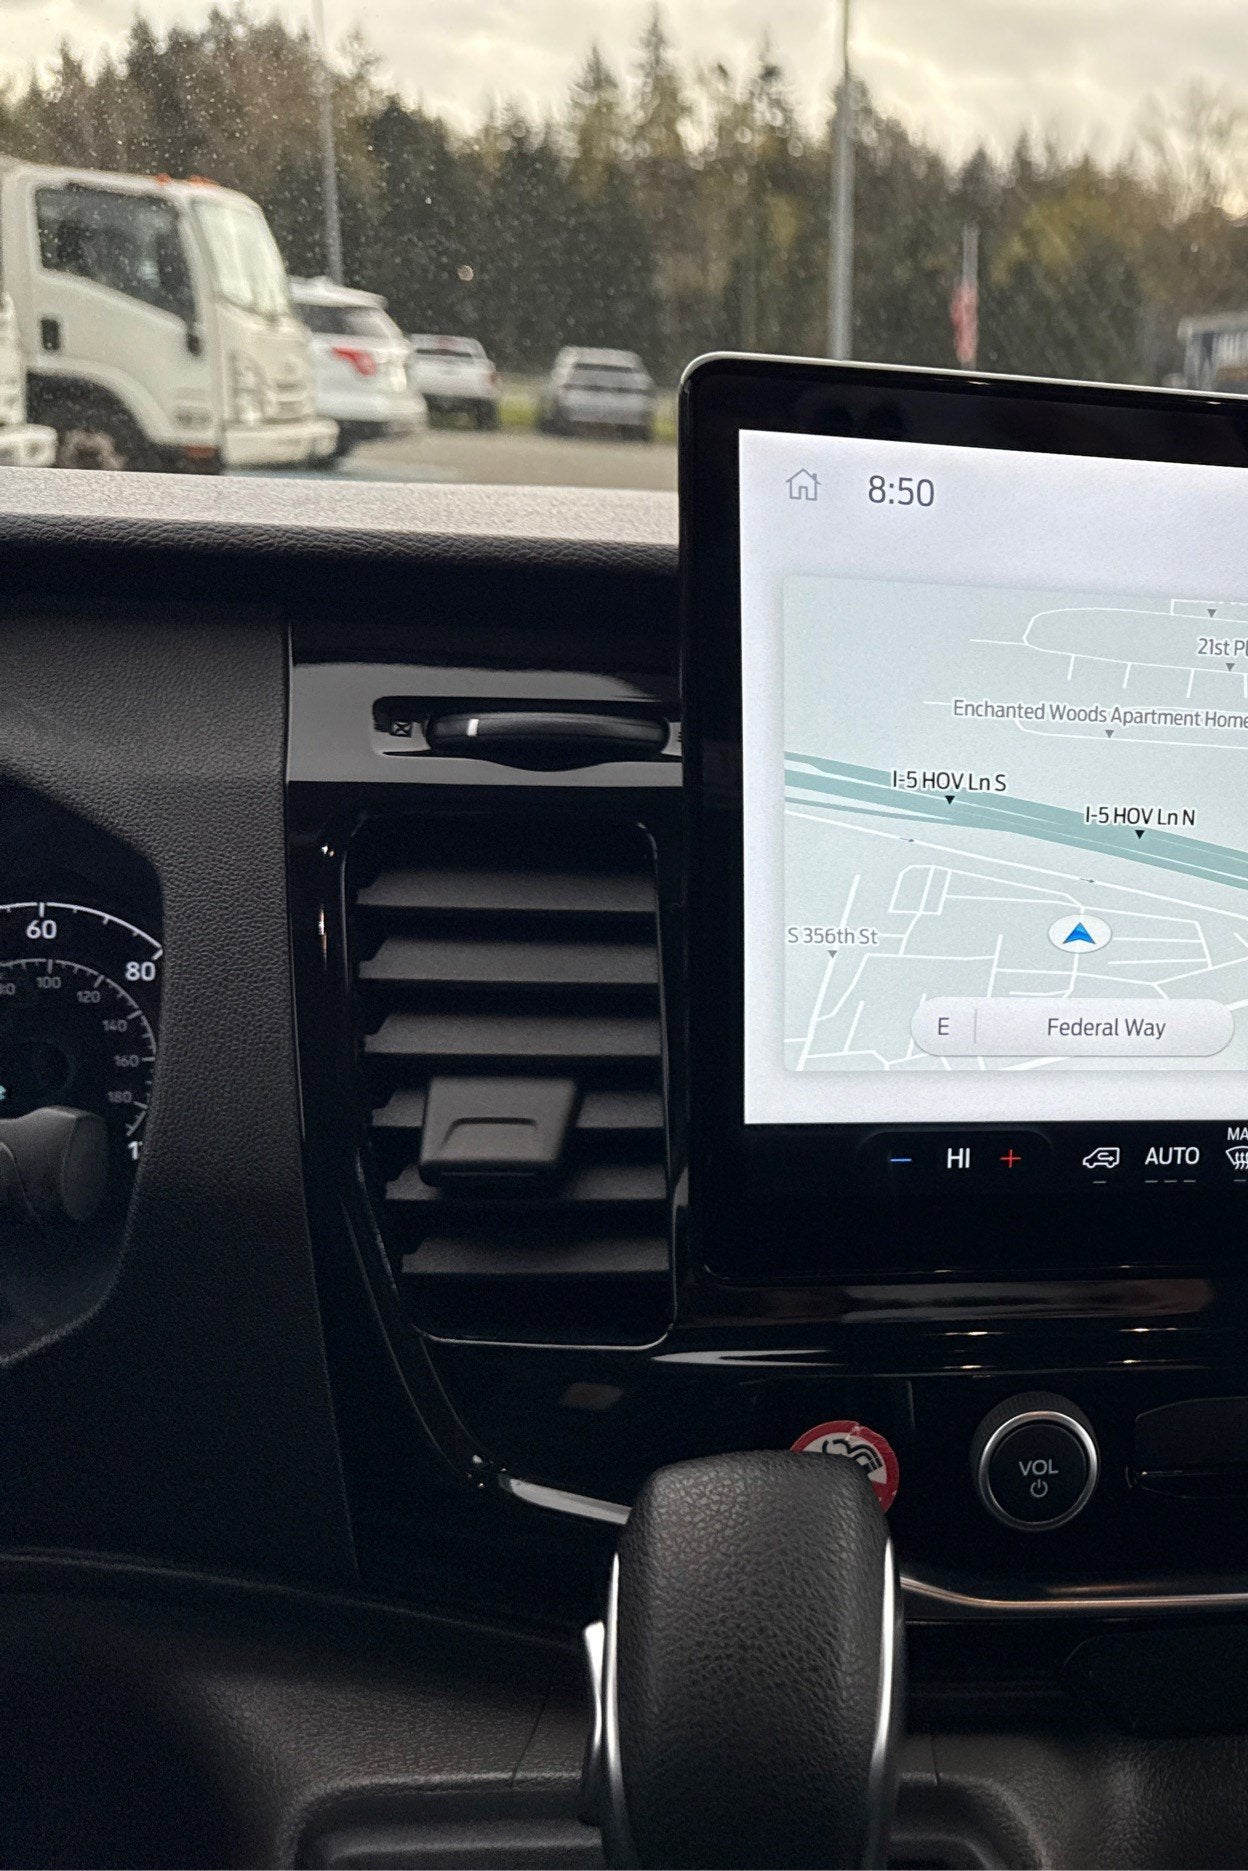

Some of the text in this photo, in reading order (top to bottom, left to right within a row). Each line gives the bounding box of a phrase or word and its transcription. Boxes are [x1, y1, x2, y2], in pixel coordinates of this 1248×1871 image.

[868, 474, 935, 507] 8:50
[1197, 637, 1230, 656] 21st
[953, 699, 1046, 721] Enchanted
[1049, 703, 1107, 723] Woods
[1110, 706, 1202, 726] Apartment
[892, 770, 1007, 792] I-5 HOV Ln S
[1085, 806, 1195, 826] I-5 HOV Ln N
[26, 919, 57, 940] 60
[787, 927, 878, 945] S 356th St
[124, 961, 156, 982] 80
[37, 976, 61, 989] 100
[76, 991, 101, 1004] 120
[102, 1019, 128, 1033] 140
[938, 1017, 950, 1036] E
[1047, 1017, 1166, 1040] Federal Way
[114, 1054, 140, 1068] 160
[107, 1090, 133, 1103] 180
[947, 1148, 971, 1169] HI
[1145, 1147, 1200, 1165] AUTO
[1018, 1459, 1059, 1476] VOL
